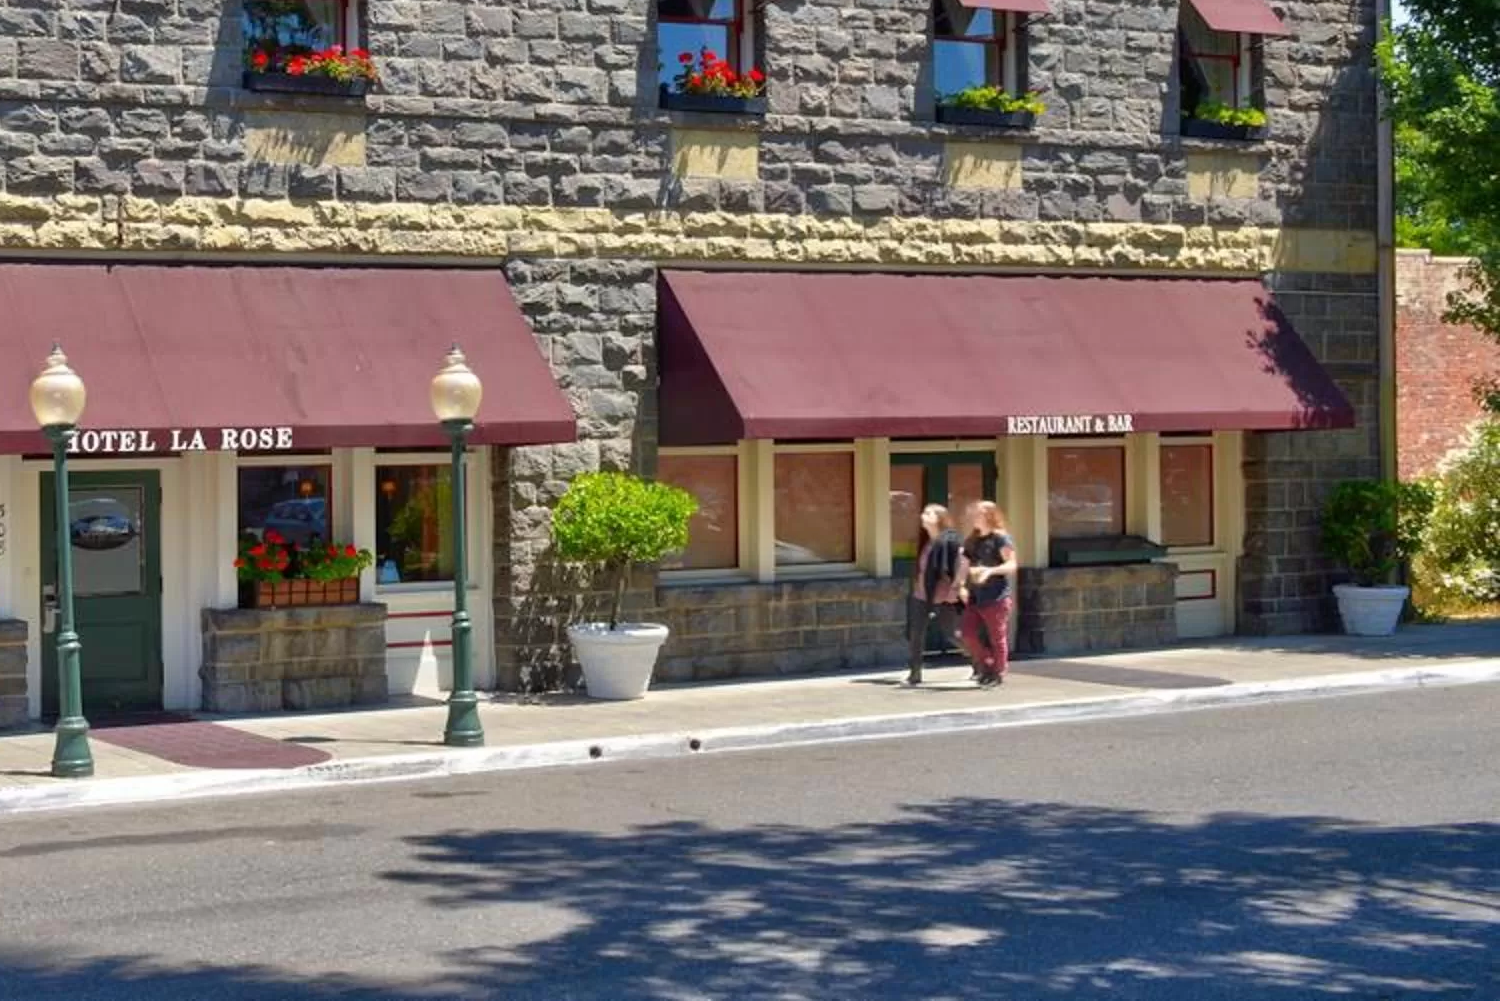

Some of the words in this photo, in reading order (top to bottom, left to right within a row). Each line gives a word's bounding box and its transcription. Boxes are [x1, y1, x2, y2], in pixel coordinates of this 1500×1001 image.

[1007, 416, 1092, 434] RESTAURANT
[1095, 417, 1105, 433] &
[1107, 414, 1134, 432] BAR
[172, 430, 206, 450] LA
[221, 427, 293, 449] ROSE
